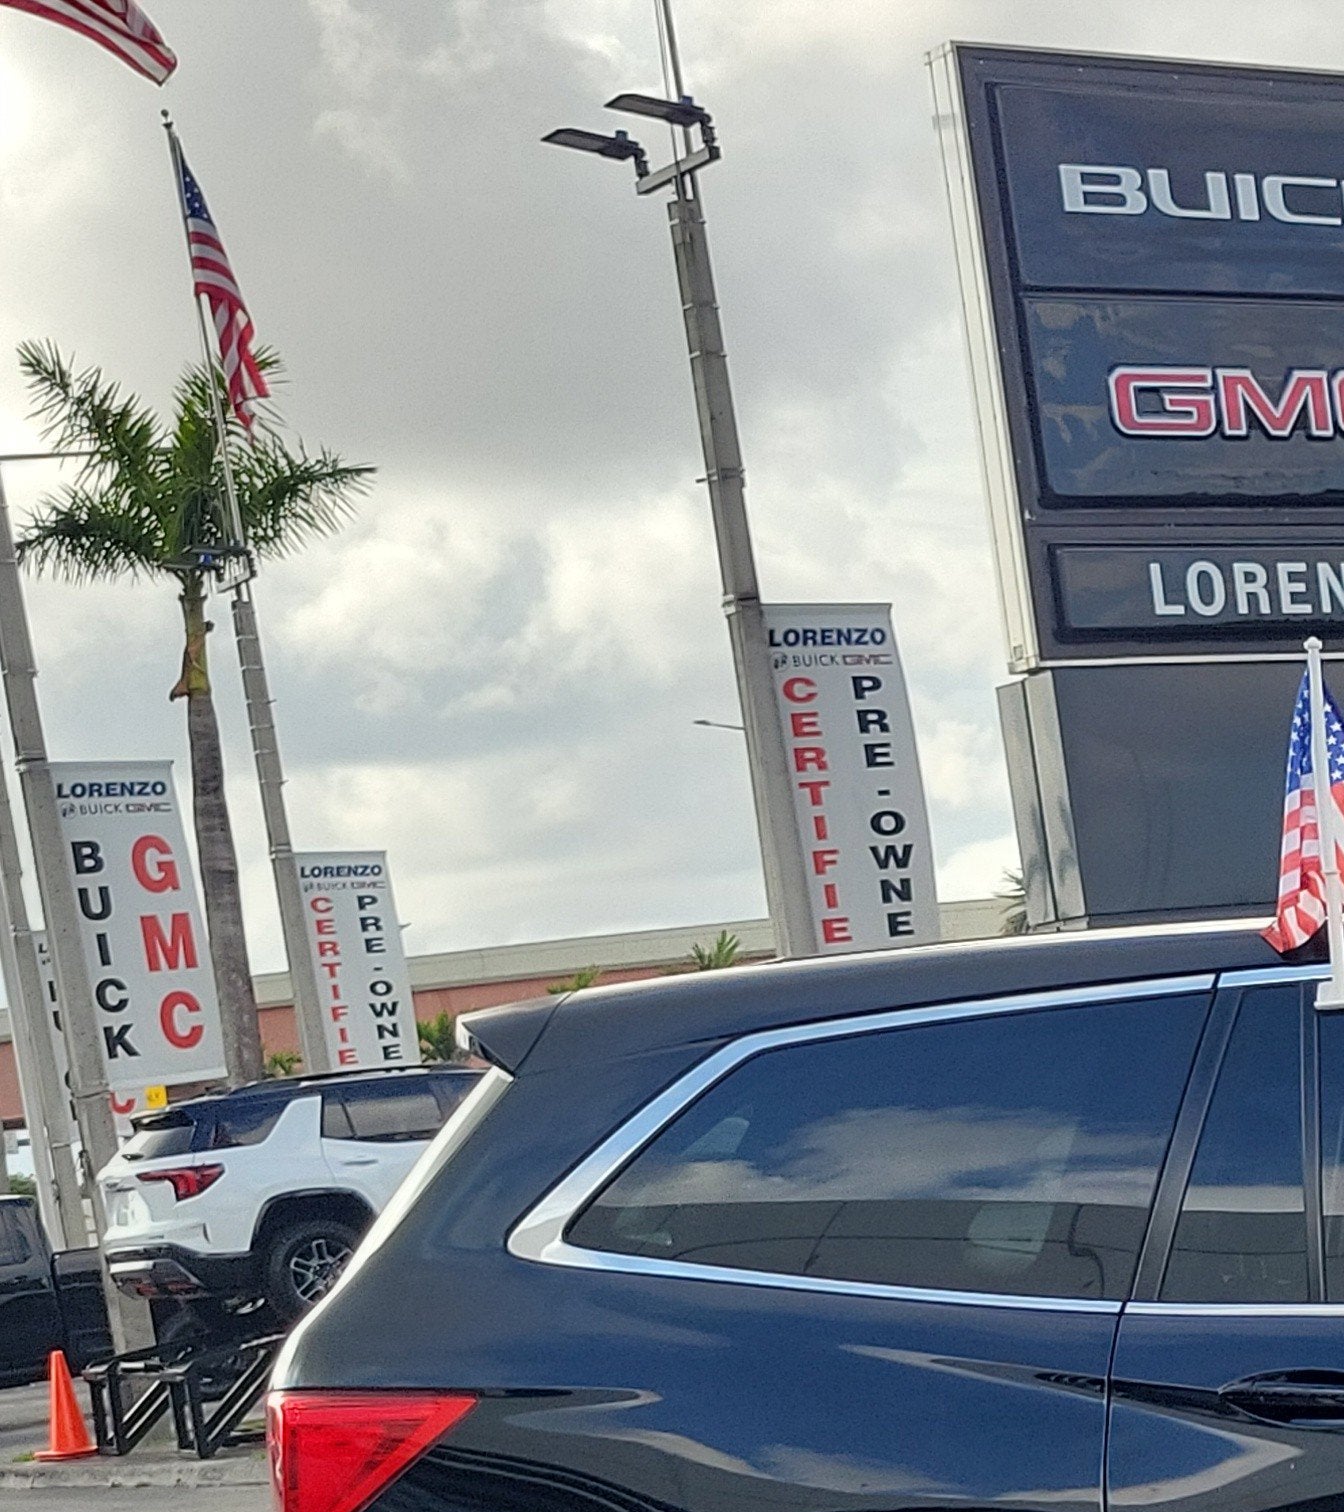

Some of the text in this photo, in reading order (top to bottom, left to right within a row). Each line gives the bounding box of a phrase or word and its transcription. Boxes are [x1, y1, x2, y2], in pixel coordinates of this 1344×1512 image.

[768, 627, 886, 648] LORENZO
[793, 653, 893, 669] BUICK GMC
[56, 780, 167, 799] LORENZO
[79, 802, 172, 815] BUICK GMC
[300, 864, 383, 879] LORENZO
[782, 676, 853, 944] CERTIFIE
[851, 675, 915, 938] PRE-OWNE
[71, 840, 141, 1060] BUICK
[131, 834, 205, 1050] GMC
[310, 896, 359, 1066] CERTIFIE
[356, 894, 403, 1060] PRE-OWNE
